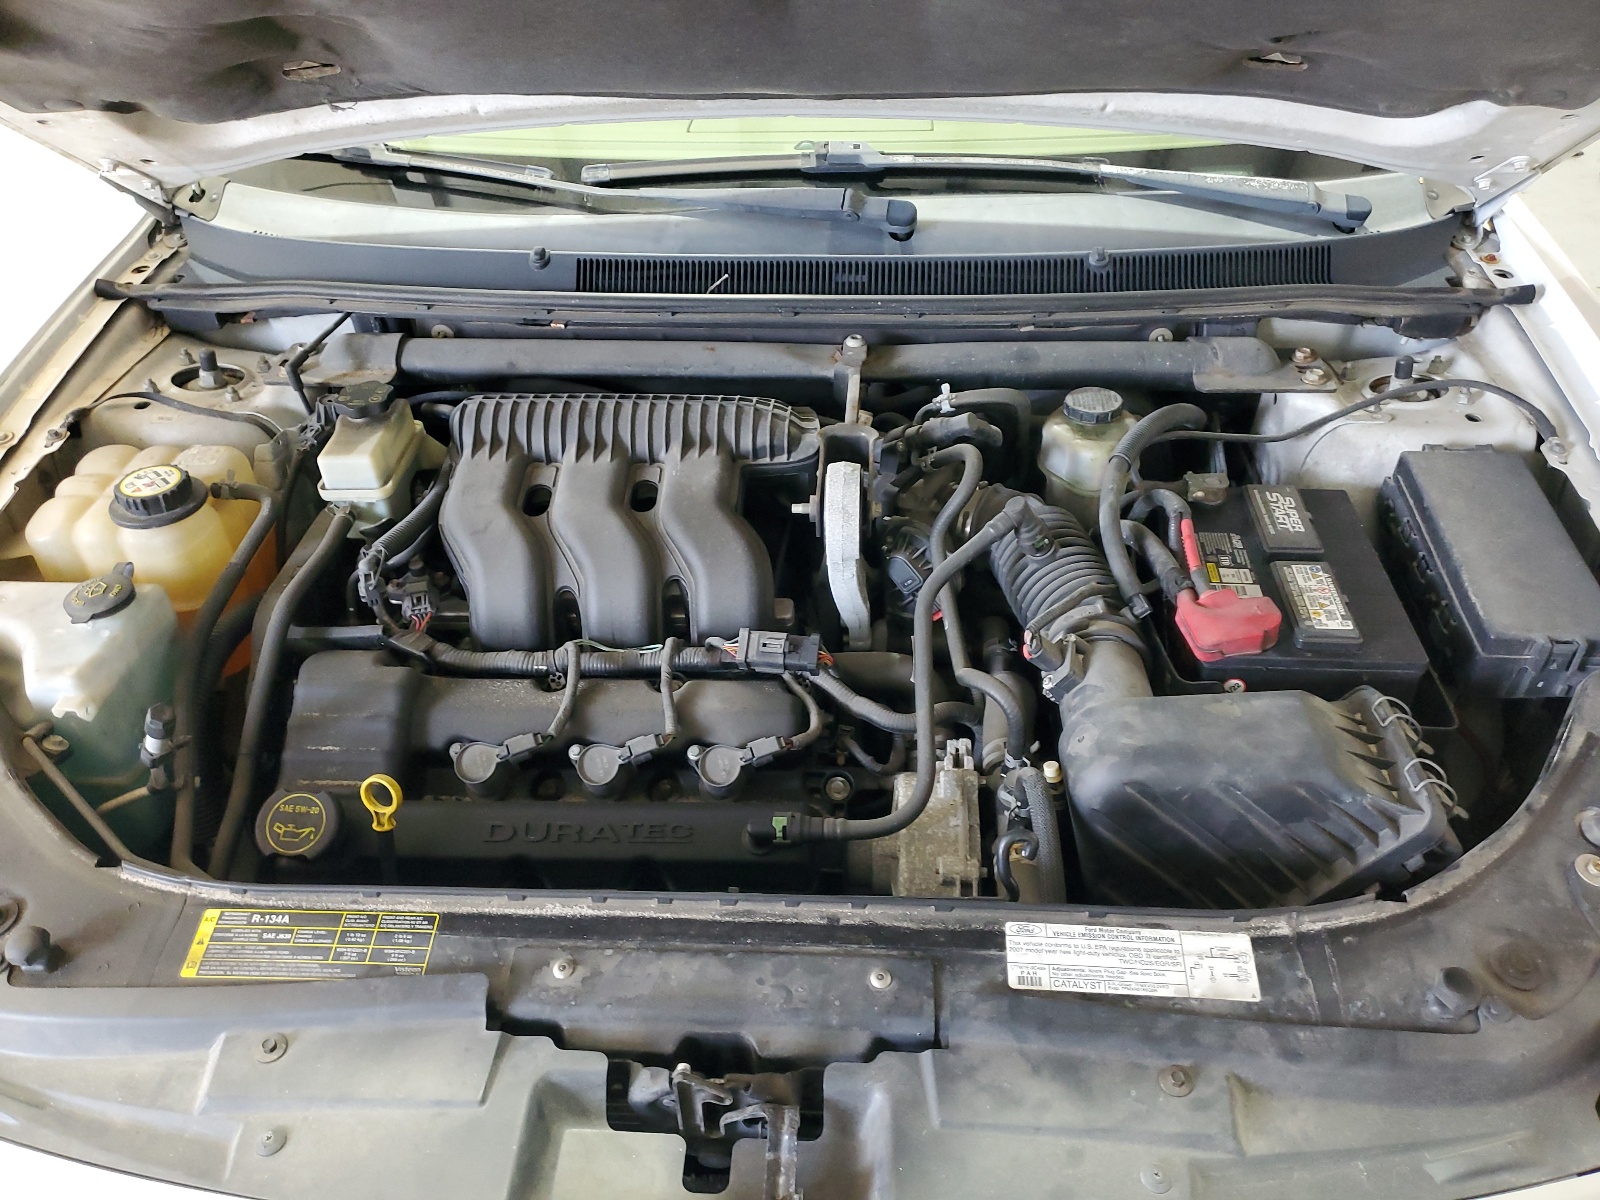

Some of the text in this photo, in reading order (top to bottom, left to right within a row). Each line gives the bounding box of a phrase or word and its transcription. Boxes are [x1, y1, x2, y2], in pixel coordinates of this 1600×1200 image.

[1265, 491, 1294, 533] START
[1284, 496, 1306, 532] SUPER
[278, 804, 320, 815] SAE 5W-20
[483, 821, 695, 844] DURATEC
[251, 914, 290, 924] R-134A
[1078, 932, 1106, 940] EMISSION
[1107, 933, 1134, 941] CONTROL
[1135, 935, 1176, 943] INFORMATION
[1116, 928, 1142, 936] Company
[1053, 979, 1103, 990] CATALYST
